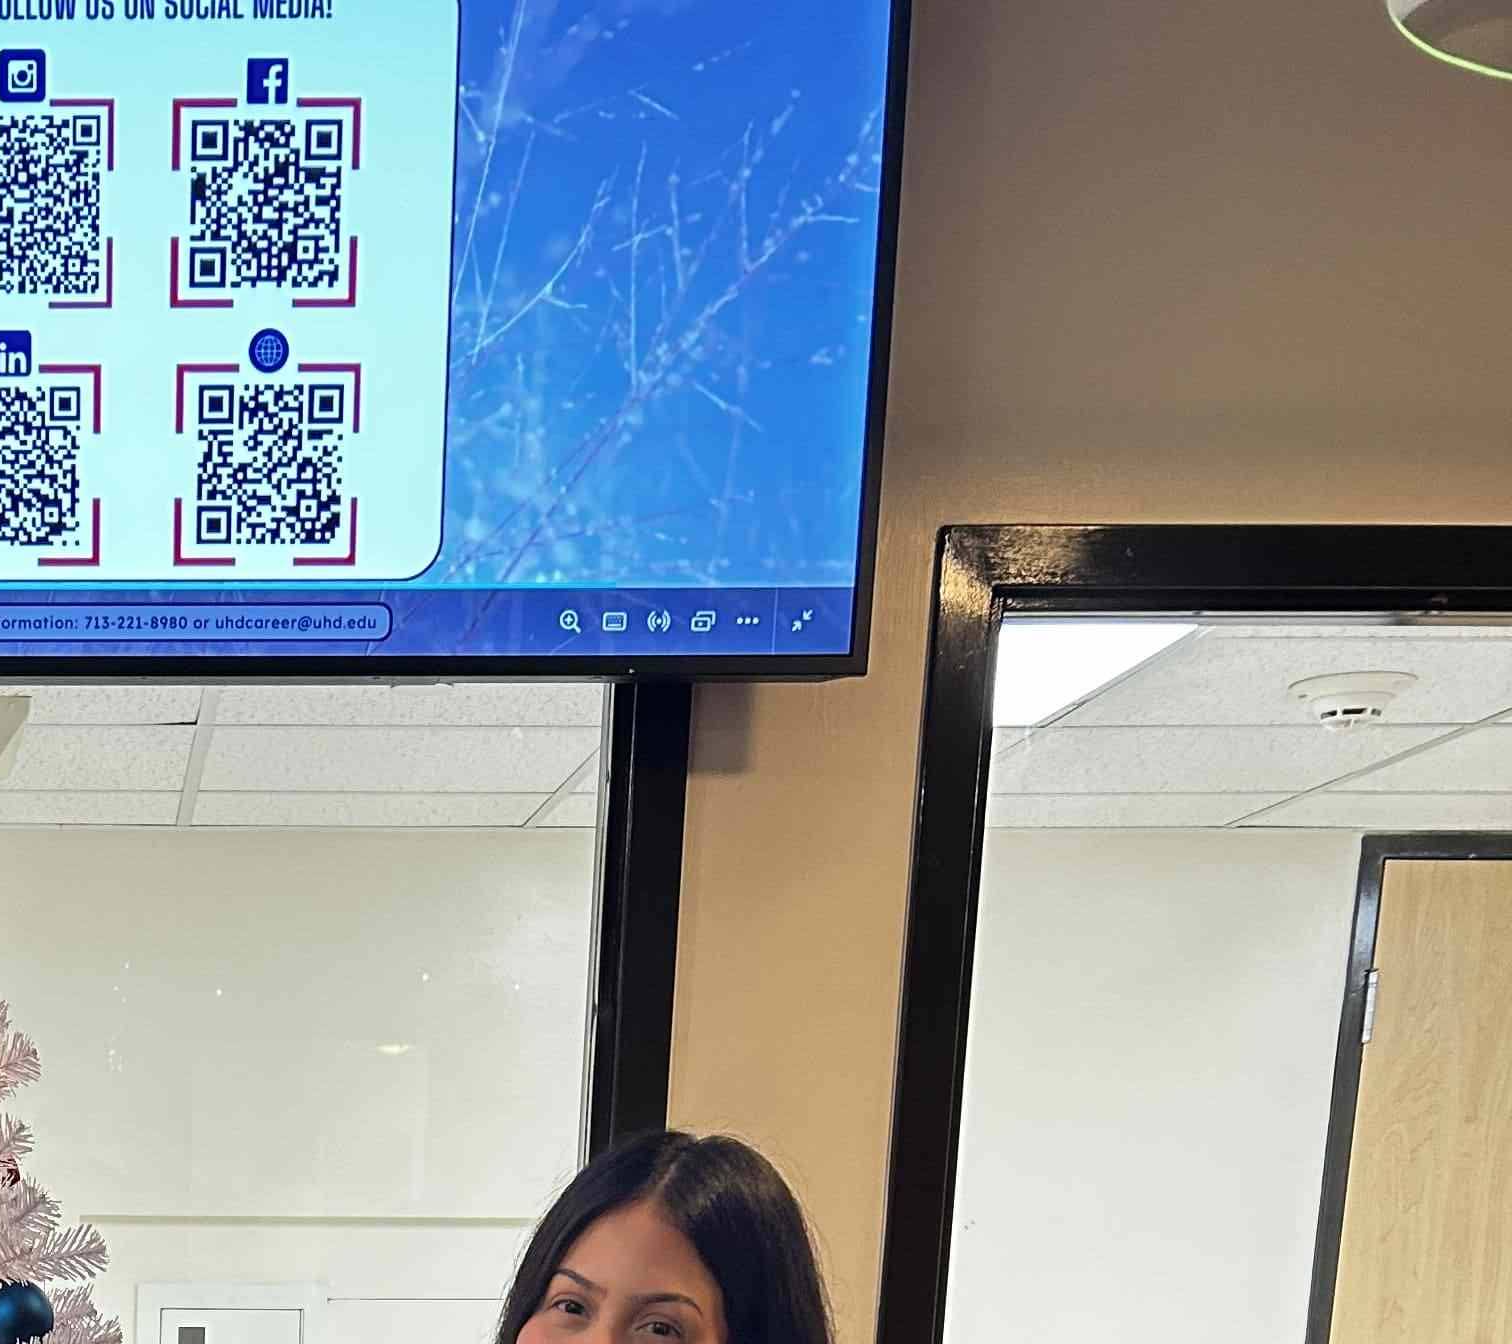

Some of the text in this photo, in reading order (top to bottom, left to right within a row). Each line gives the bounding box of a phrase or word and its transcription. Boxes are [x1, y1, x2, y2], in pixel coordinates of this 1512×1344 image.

[84, 616, 188, 631] 713-221-8980
[193, 618, 210, 631] or
[215, 615, 378, 632] uhdcareer@uhd.edu
